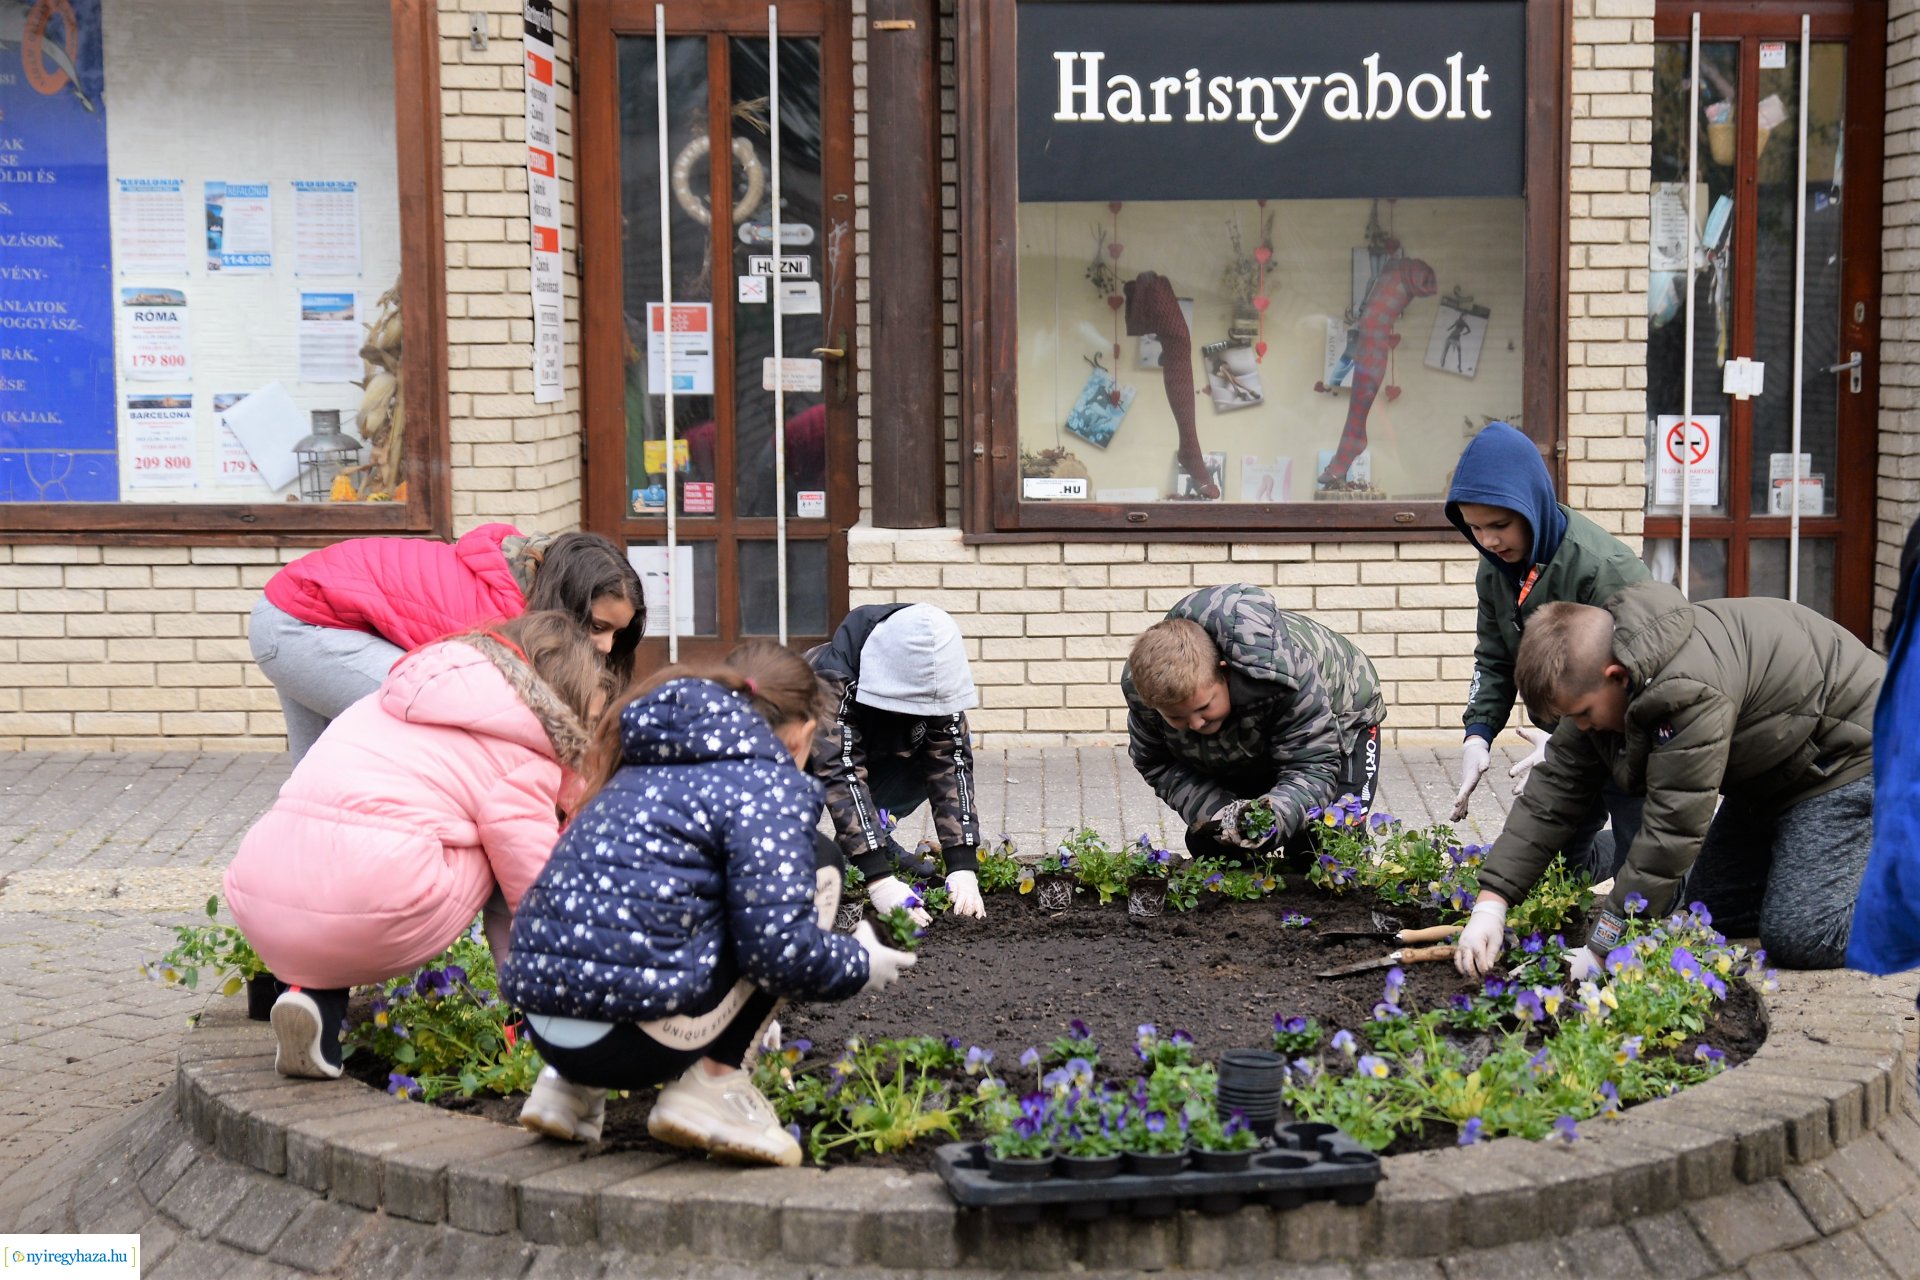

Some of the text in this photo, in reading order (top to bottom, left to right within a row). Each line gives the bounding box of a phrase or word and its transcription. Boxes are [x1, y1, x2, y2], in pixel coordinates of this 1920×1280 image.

[1053, 51, 1492, 143] Harisnyabolt
[132, 355, 185, 367] 179 800
[130, 411, 190, 419] BARCELONA
[135, 456, 191, 469] 209 800
[662, 1020, 706, 1041] UNIQUE
